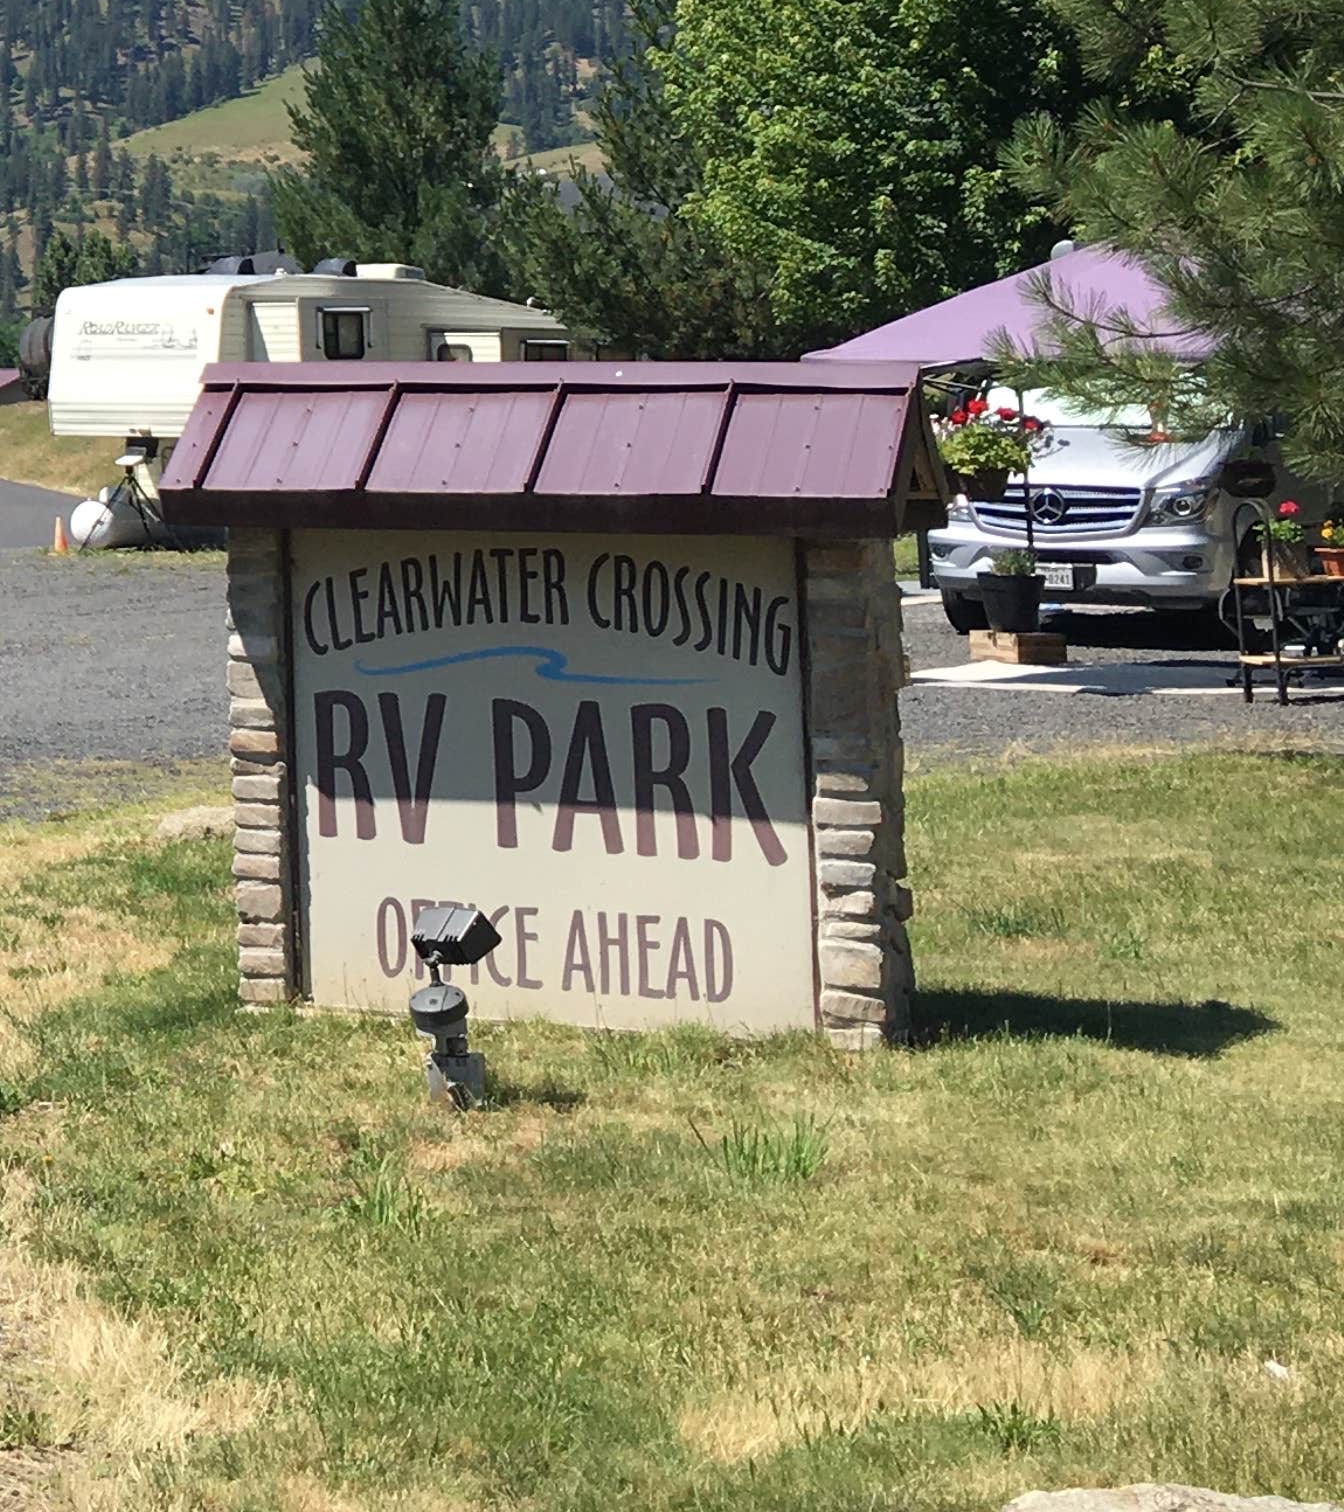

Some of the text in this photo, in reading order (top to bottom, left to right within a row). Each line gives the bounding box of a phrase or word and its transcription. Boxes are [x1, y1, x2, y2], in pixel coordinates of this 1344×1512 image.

[303, 547, 791, 676] CLEARWATER CROSSING
[313, 690, 789, 867] RV PARK
[561, 909, 734, 1003] AHEAD
